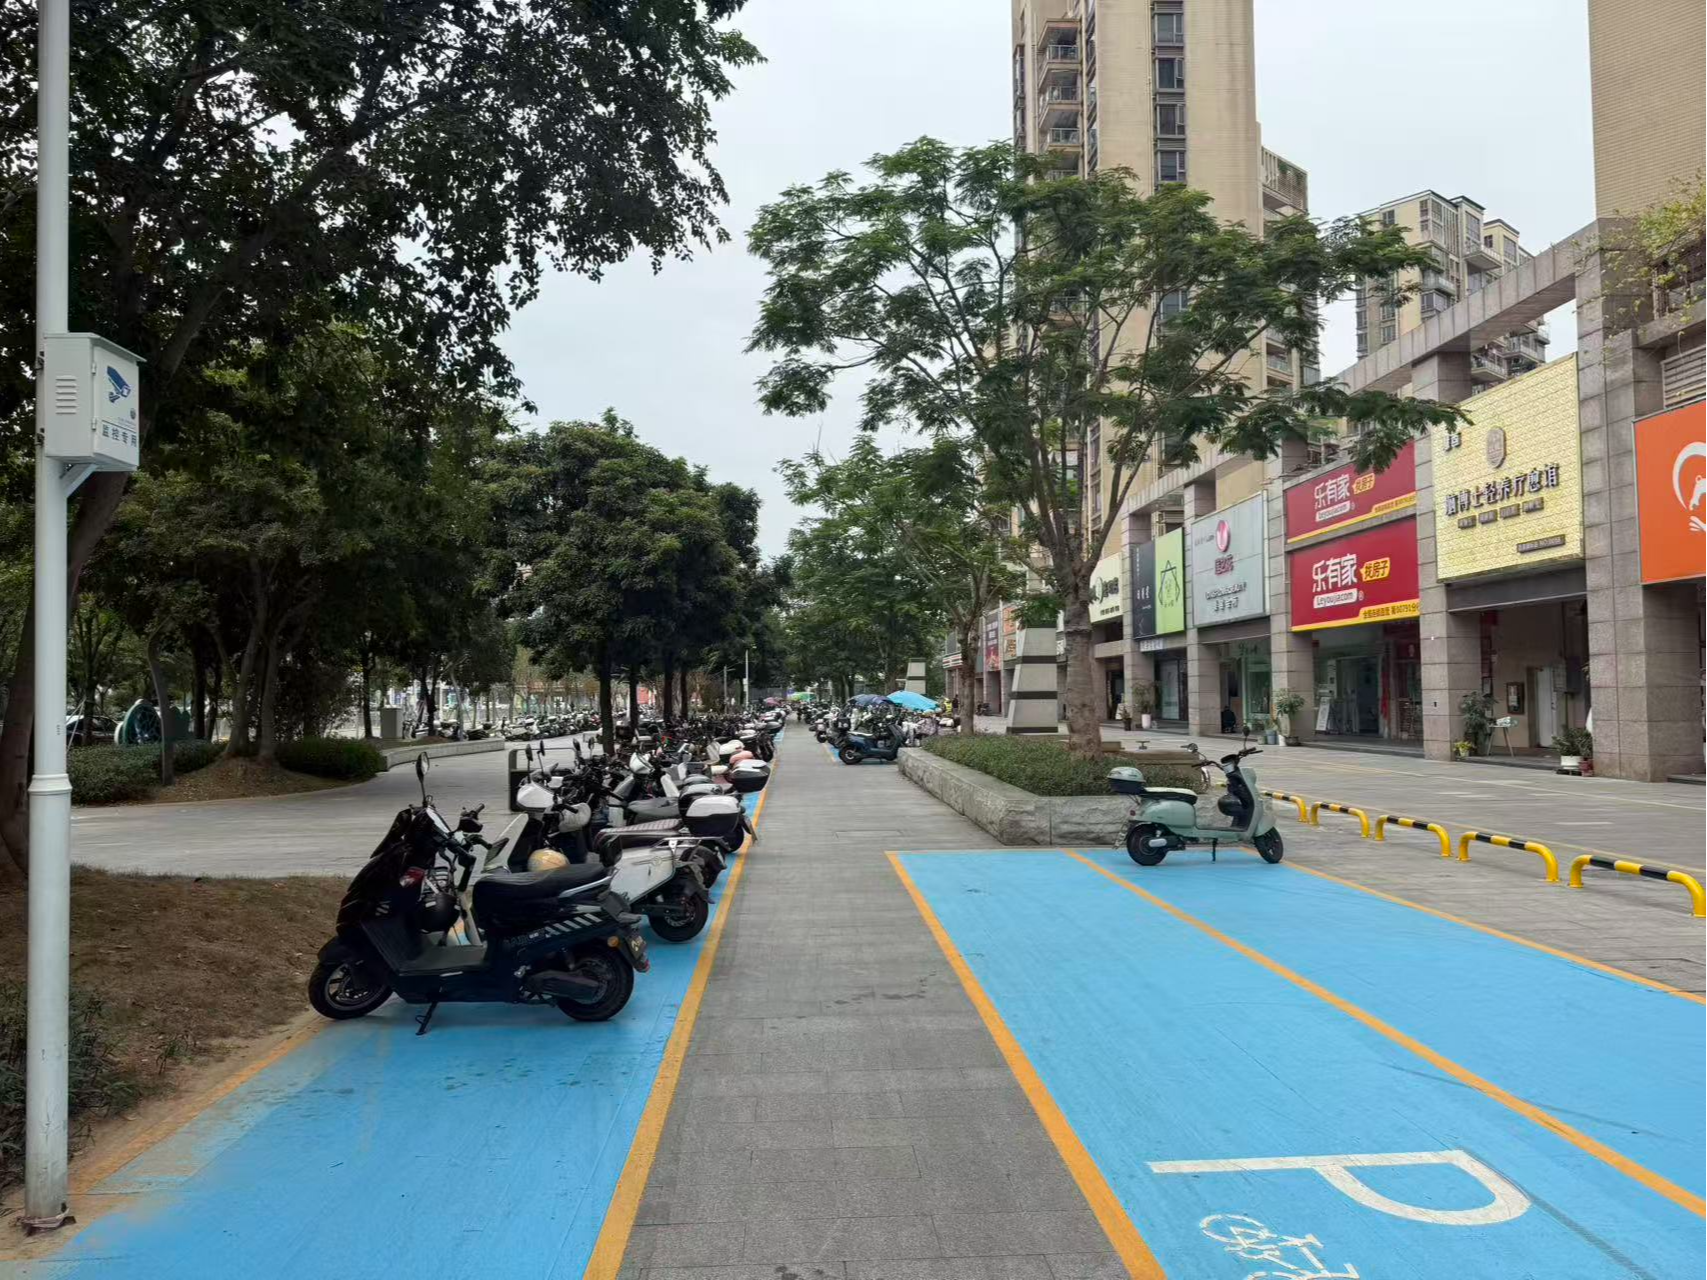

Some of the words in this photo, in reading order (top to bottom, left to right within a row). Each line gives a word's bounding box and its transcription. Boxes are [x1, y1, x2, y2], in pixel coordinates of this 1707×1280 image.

[1314, 474, 1350, 509] 乐有家
[1312, 553, 1357, 592] 乐有家
[1364, 560, 1388, 579] 找房子
[1146, 1149, 1533, 1226] P
